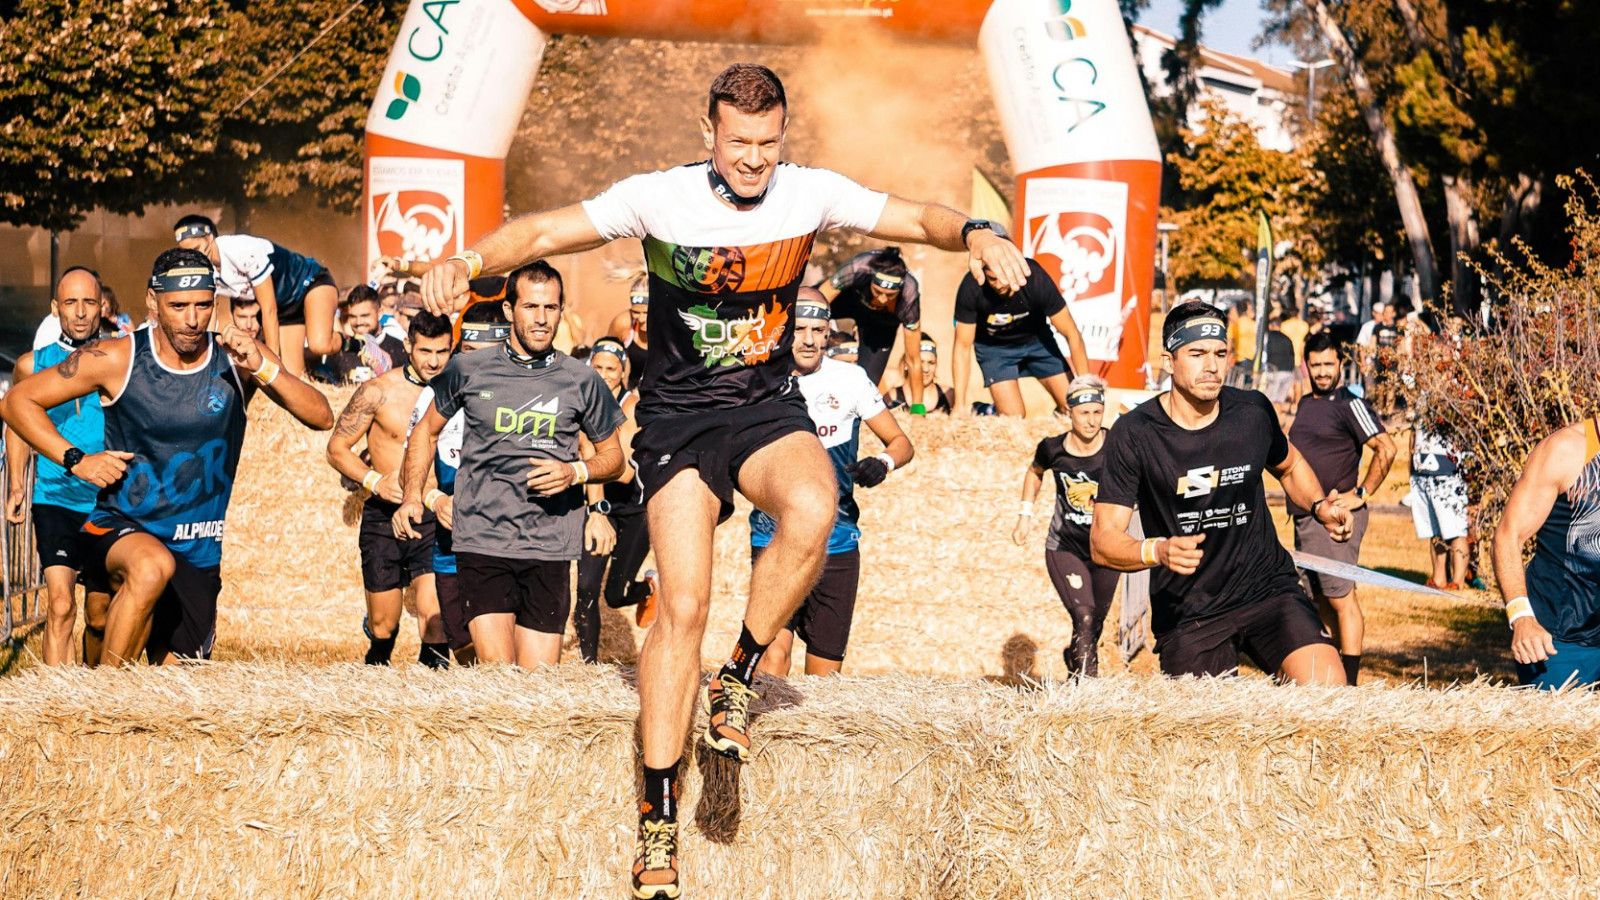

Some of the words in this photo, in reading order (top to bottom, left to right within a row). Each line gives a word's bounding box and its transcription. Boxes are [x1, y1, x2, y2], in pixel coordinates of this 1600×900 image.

[408, 0, 460, 62] CA
[1053, 57, 1106, 133] CA
[178, 275, 202, 288] 87
[802, 306, 819, 316] 71
[463, 330, 479, 340] 72
[1200, 324, 1220, 336] 93
[1221, 464, 1251, 476] STONE
[117, 438, 231, 517] OCR
[1220, 472, 1245, 482] RACE
